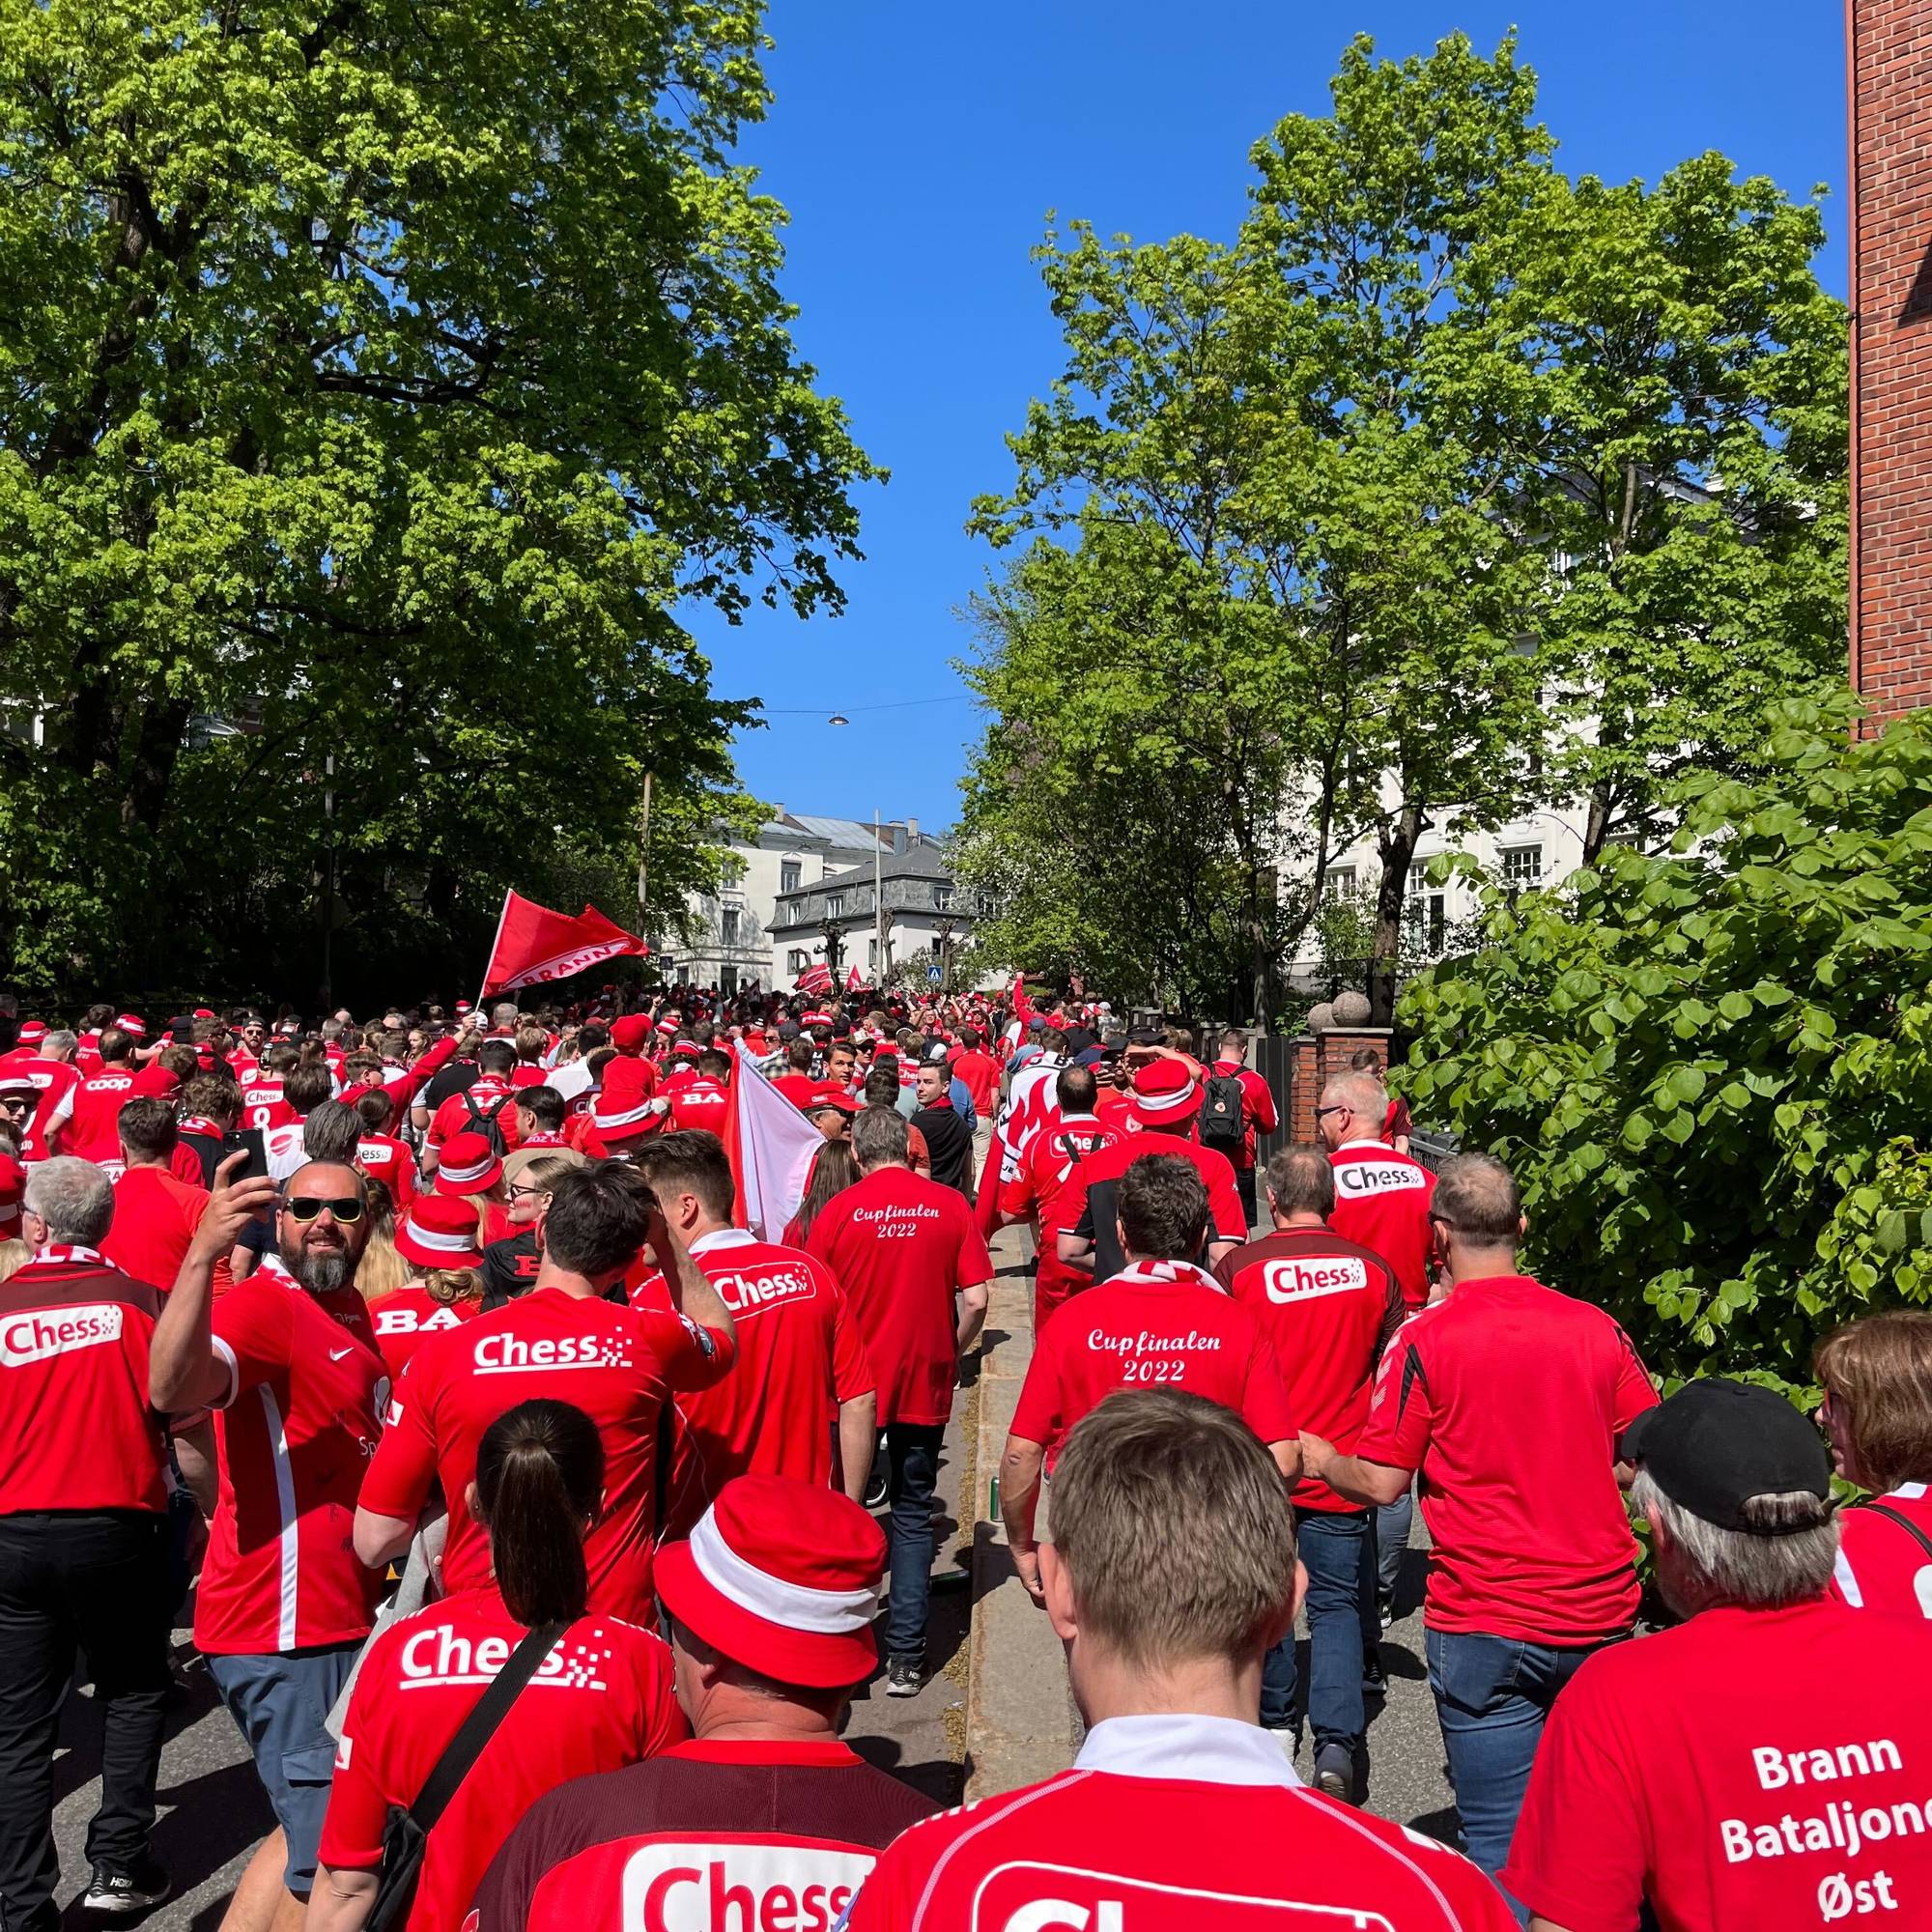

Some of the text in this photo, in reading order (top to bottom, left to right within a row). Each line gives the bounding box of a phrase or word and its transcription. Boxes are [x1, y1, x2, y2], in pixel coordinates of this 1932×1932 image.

[523, 946, 611, 985] BRANN
[87, 1077, 132, 1091] coop
[248, 1092, 276, 1102] Chess
[682, 1093, 725, 1105] BA
[1341, 1166, 1409, 1190] Chess
[853, 1204, 940, 1222] Cupfinalen
[877, 1223, 917, 1238] 2022
[713, 1272, 797, 1311] Chess
[1271, 1264, 1350, 1293] Chess
[5, 1318, 100, 1354] Chess
[474, 1332, 599, 1368] Chess
[1088, 1329, 1221, 1356] Cupfinalen
[1123, 1360, 1185, 1381] 2022
[401, 1625, 565, 1678] Ches
[1752, 1739, 1902, 1789] Brann
[1818, 1870, 1898, 1923] Øst
